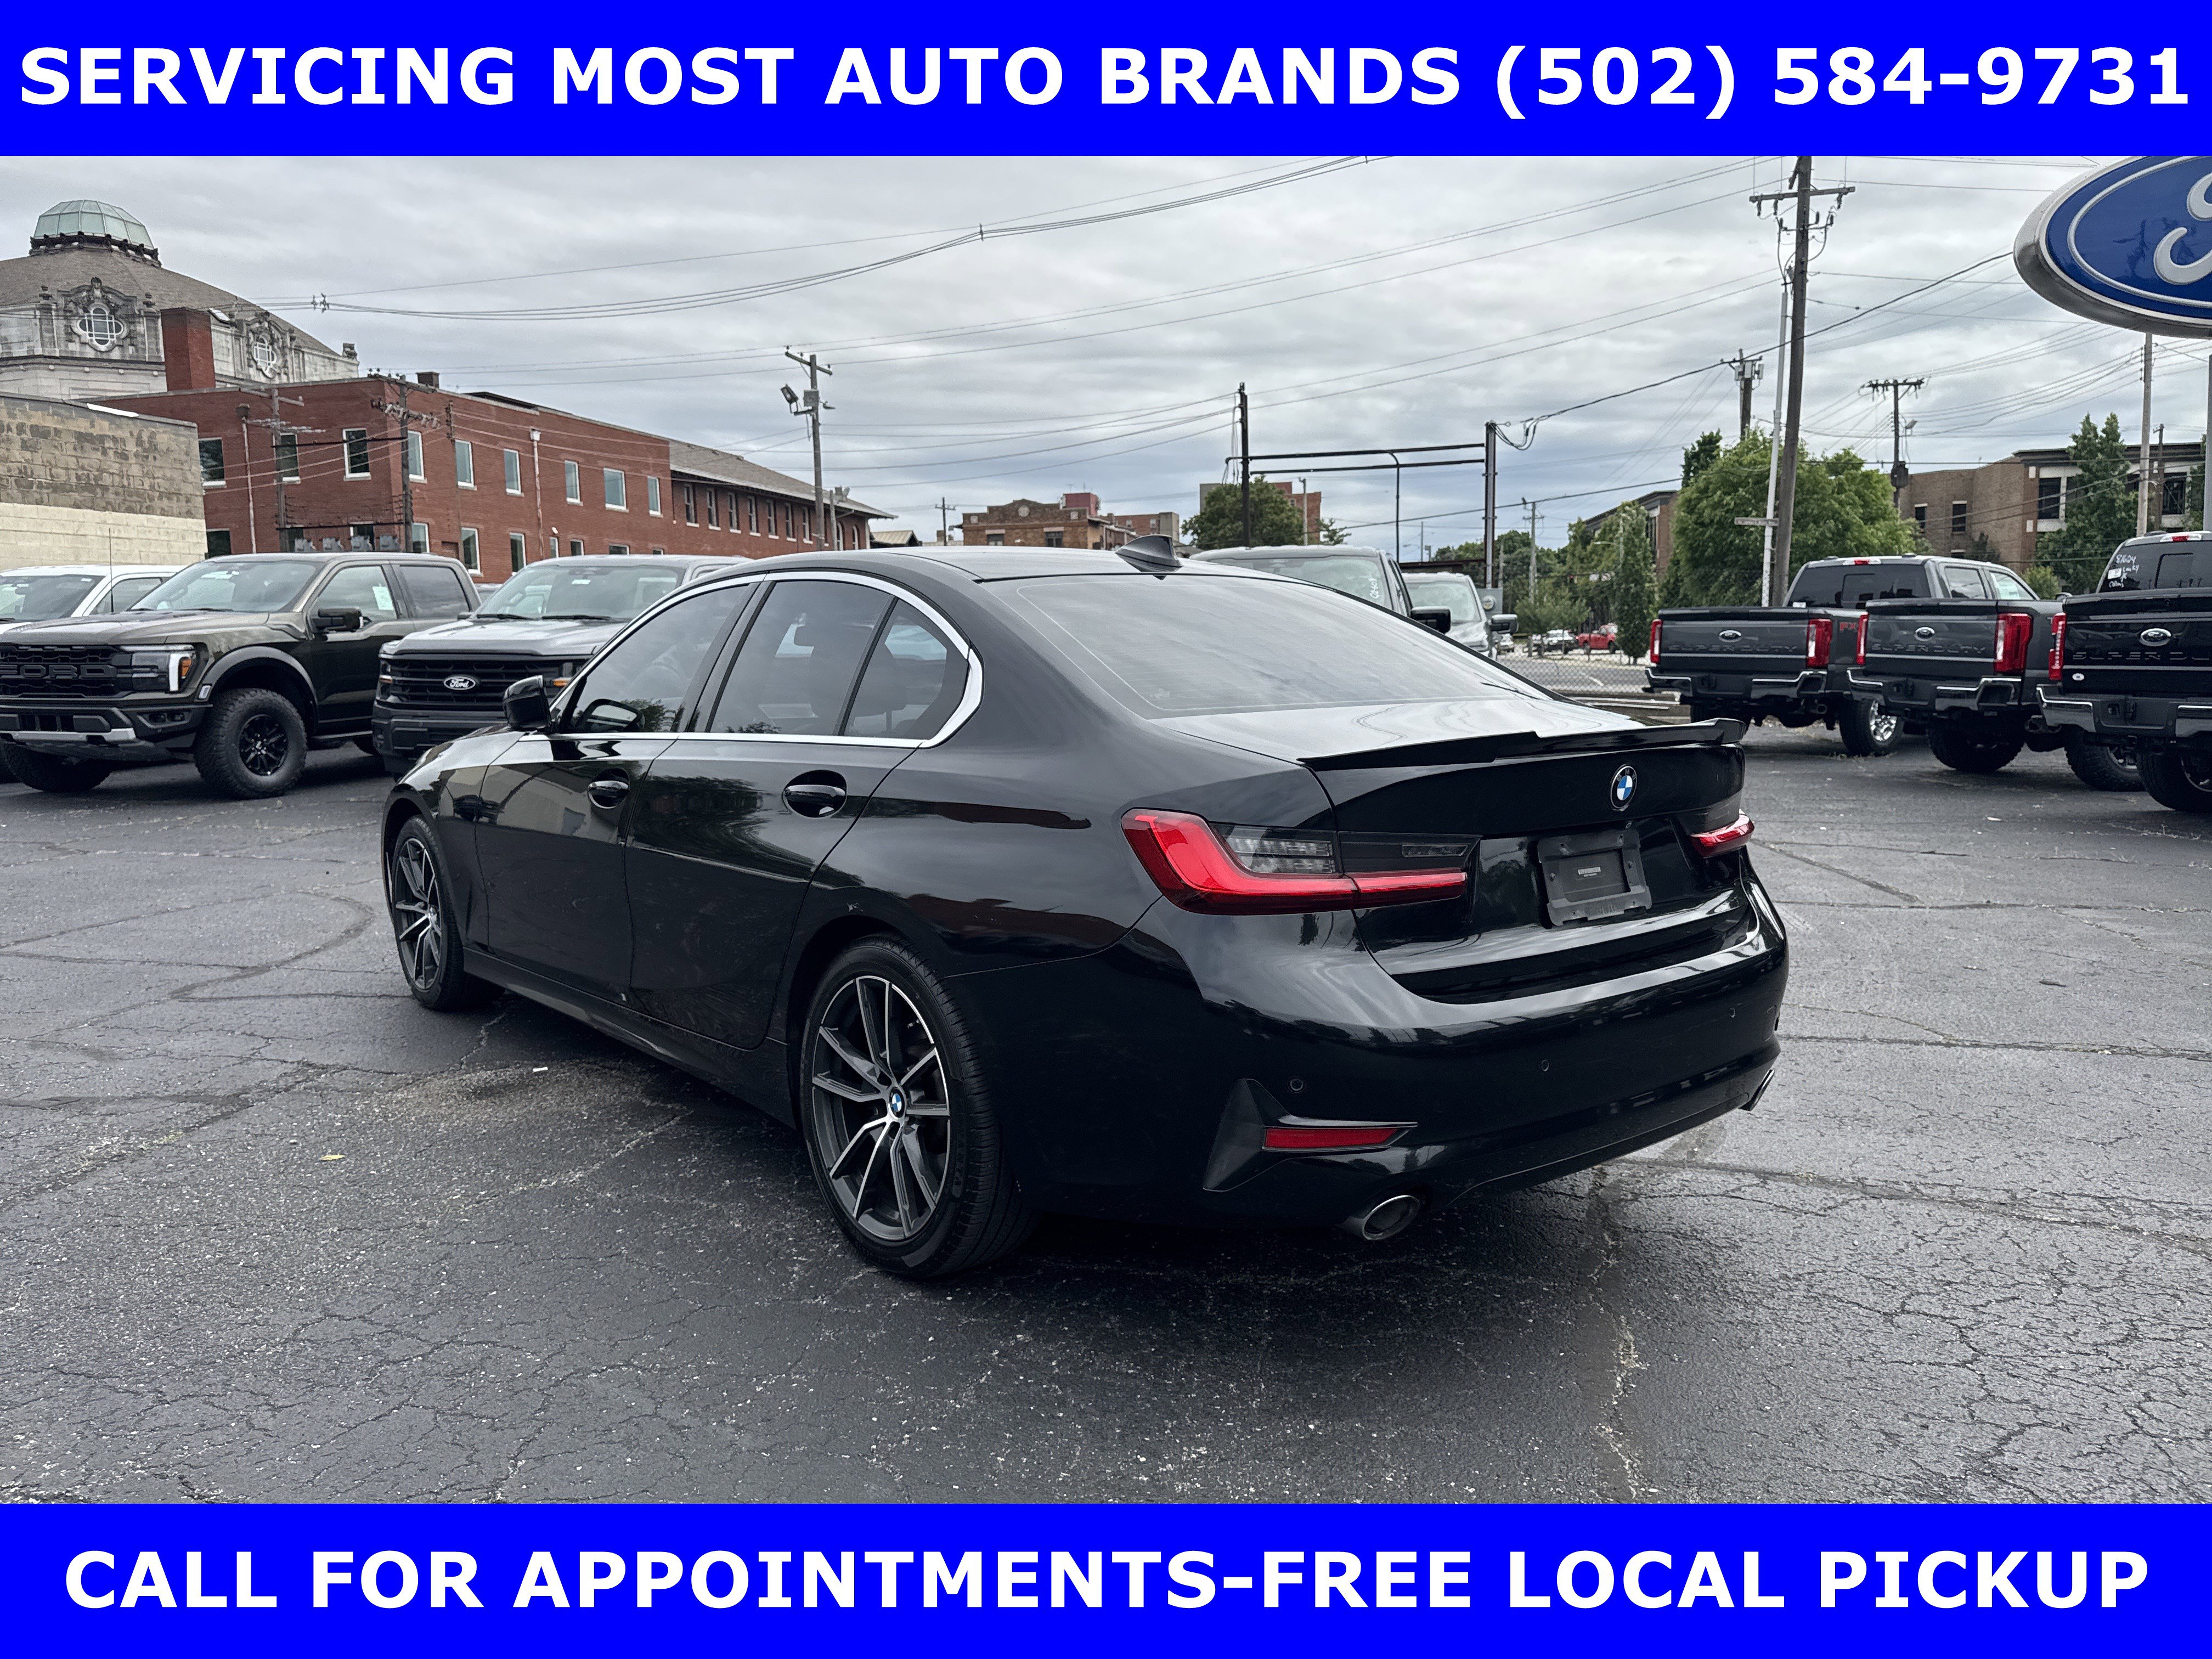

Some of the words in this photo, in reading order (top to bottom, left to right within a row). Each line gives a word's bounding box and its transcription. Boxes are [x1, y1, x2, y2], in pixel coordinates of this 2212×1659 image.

[1871, 643, 1928, 652] SUPER
[1933, 645, 1986, 654] DUTY
[2072, 651, 2161, 661] SUPER
[449, 678, 470, 689] Ford
